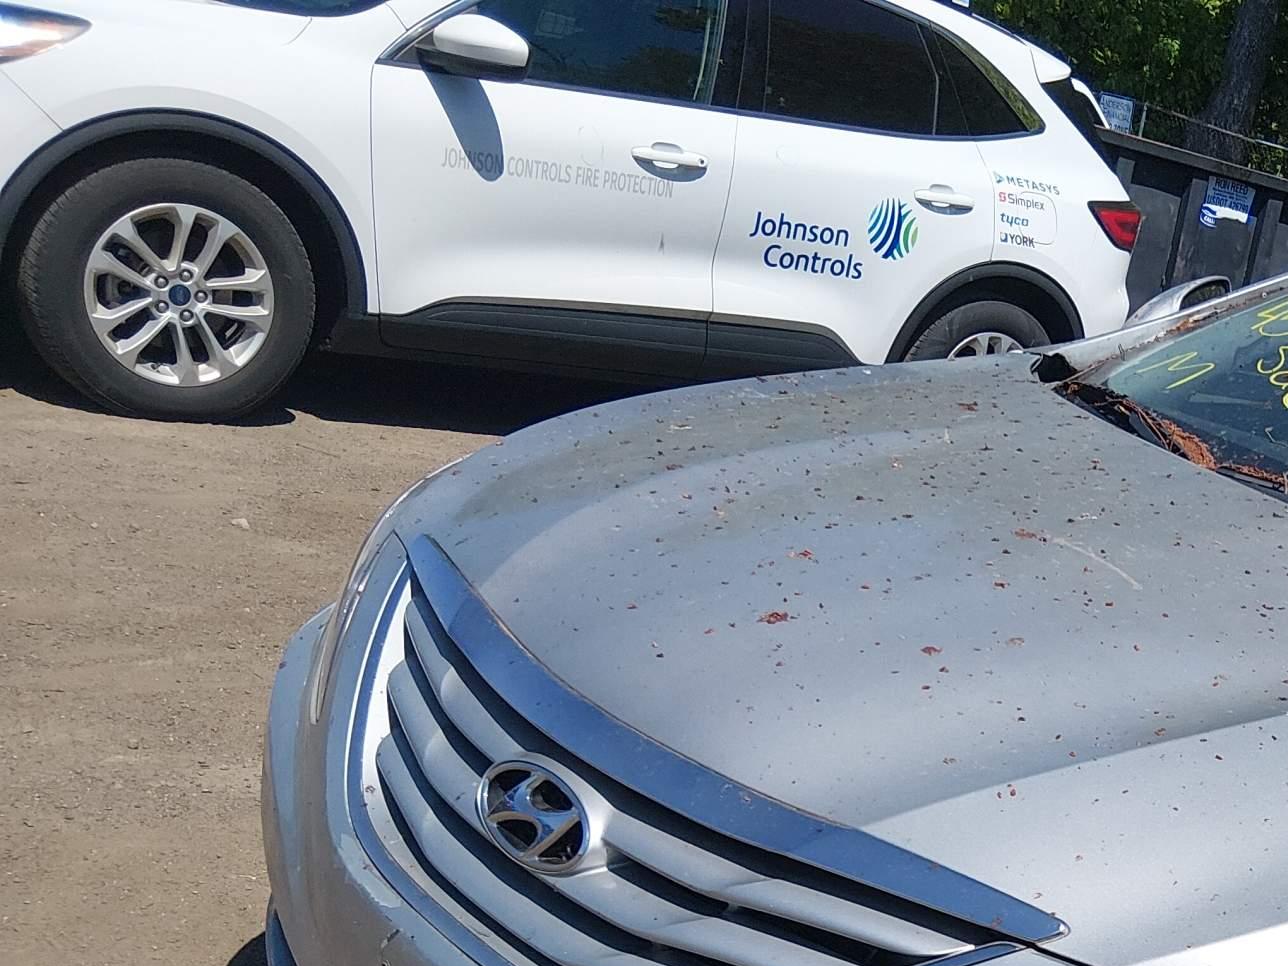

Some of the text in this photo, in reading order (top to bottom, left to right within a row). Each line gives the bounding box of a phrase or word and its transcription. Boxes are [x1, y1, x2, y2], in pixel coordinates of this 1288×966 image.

[441, 147, 674, 199] JOHNSON CONTROLS FIRE PROTECTION
[1006, 175, 1060, 196] METASYS
[1008, 193, 1045, 210] Simplex
[749, 211, 849, 247] Johnson
[1000, 212, 1029, 227] tyco
[1008, 233, 1036, 248] YORK
[763, 244, 863, 279] Controls
